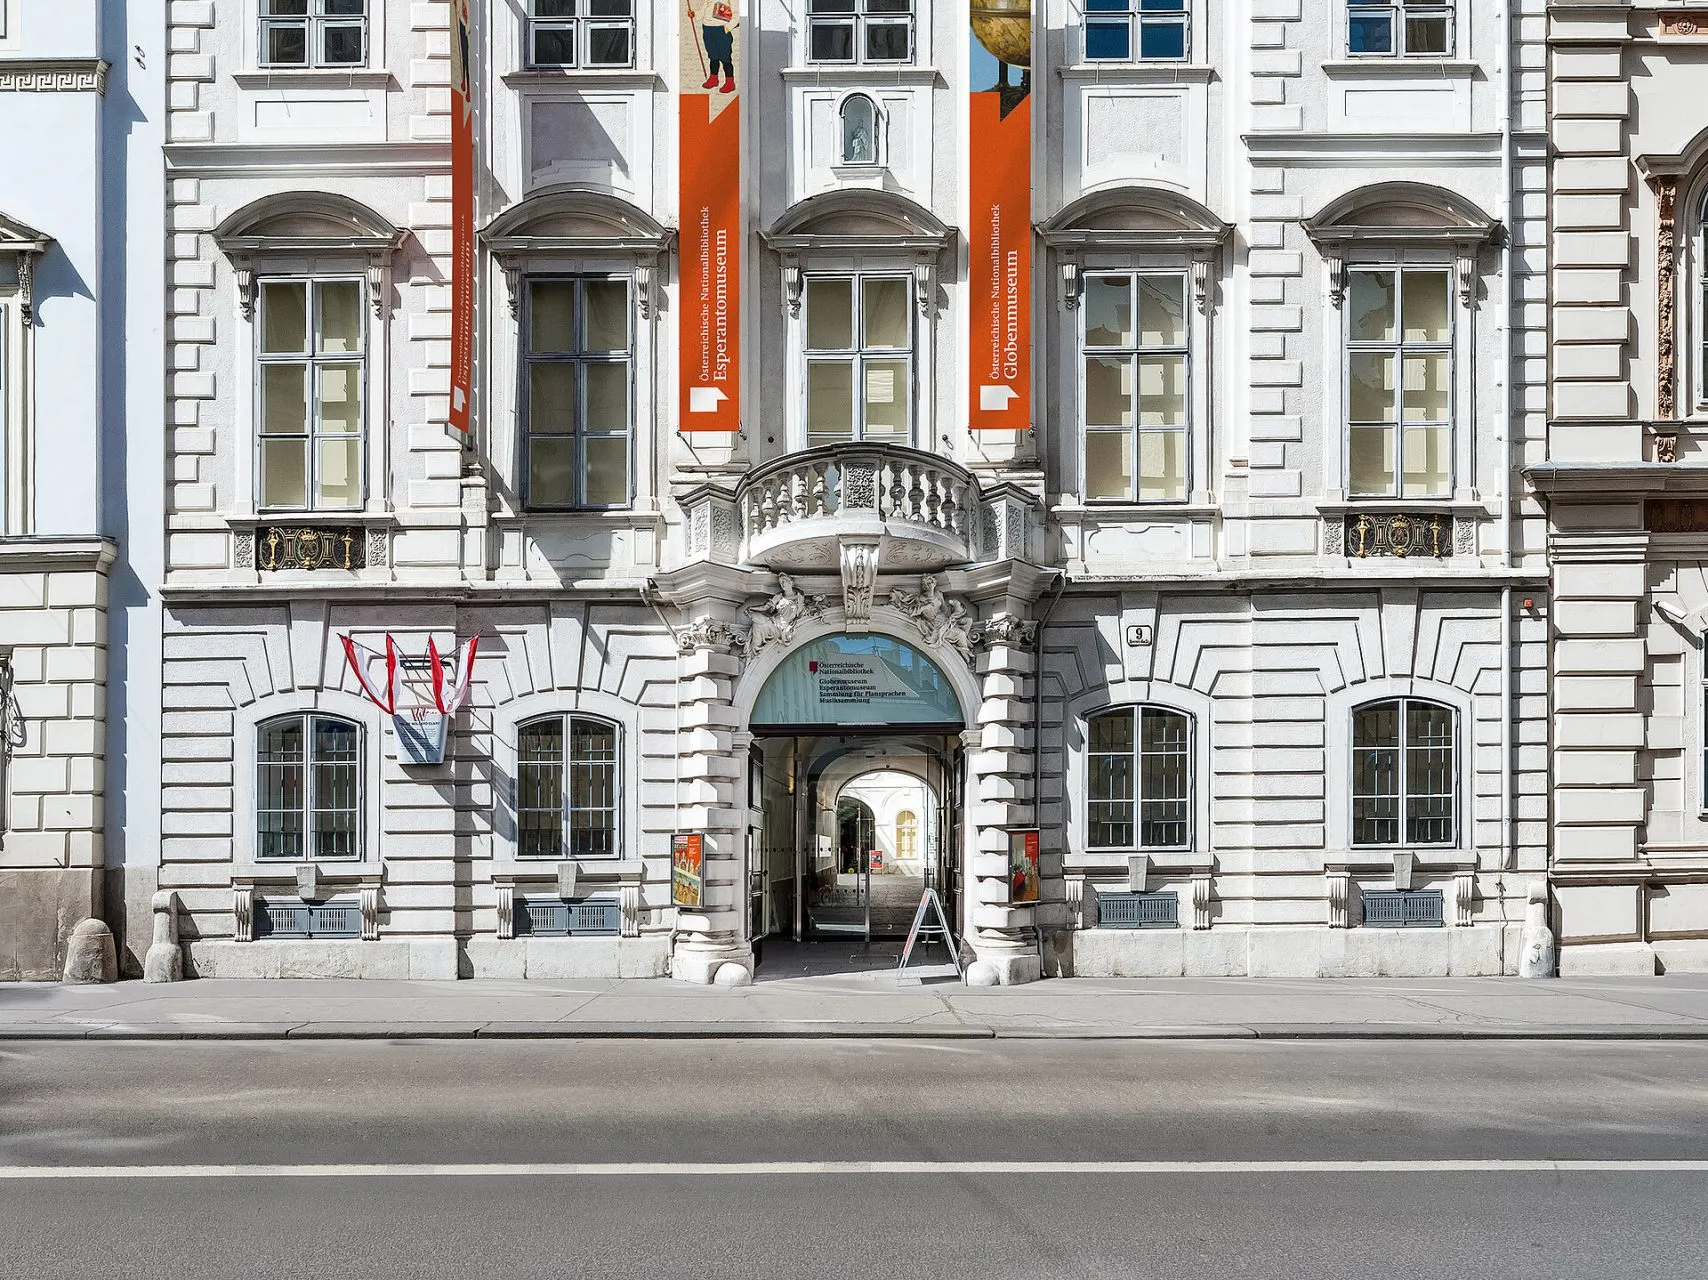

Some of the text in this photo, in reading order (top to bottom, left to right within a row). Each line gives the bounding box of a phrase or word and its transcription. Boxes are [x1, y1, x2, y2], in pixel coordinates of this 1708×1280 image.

[462, 241, 470, 385] Esperantomuseum
[699, 206, 709, 382] Österreichische Nationalbibliothek
[713, 228, 731, 382] Esperantomuseum
[988, 203, 1000, 380] Österreichische Nationalbibliothek
[1003, 249, 1018, 380] Globenmuseum
[1135, 627, 1143, 640] 9
